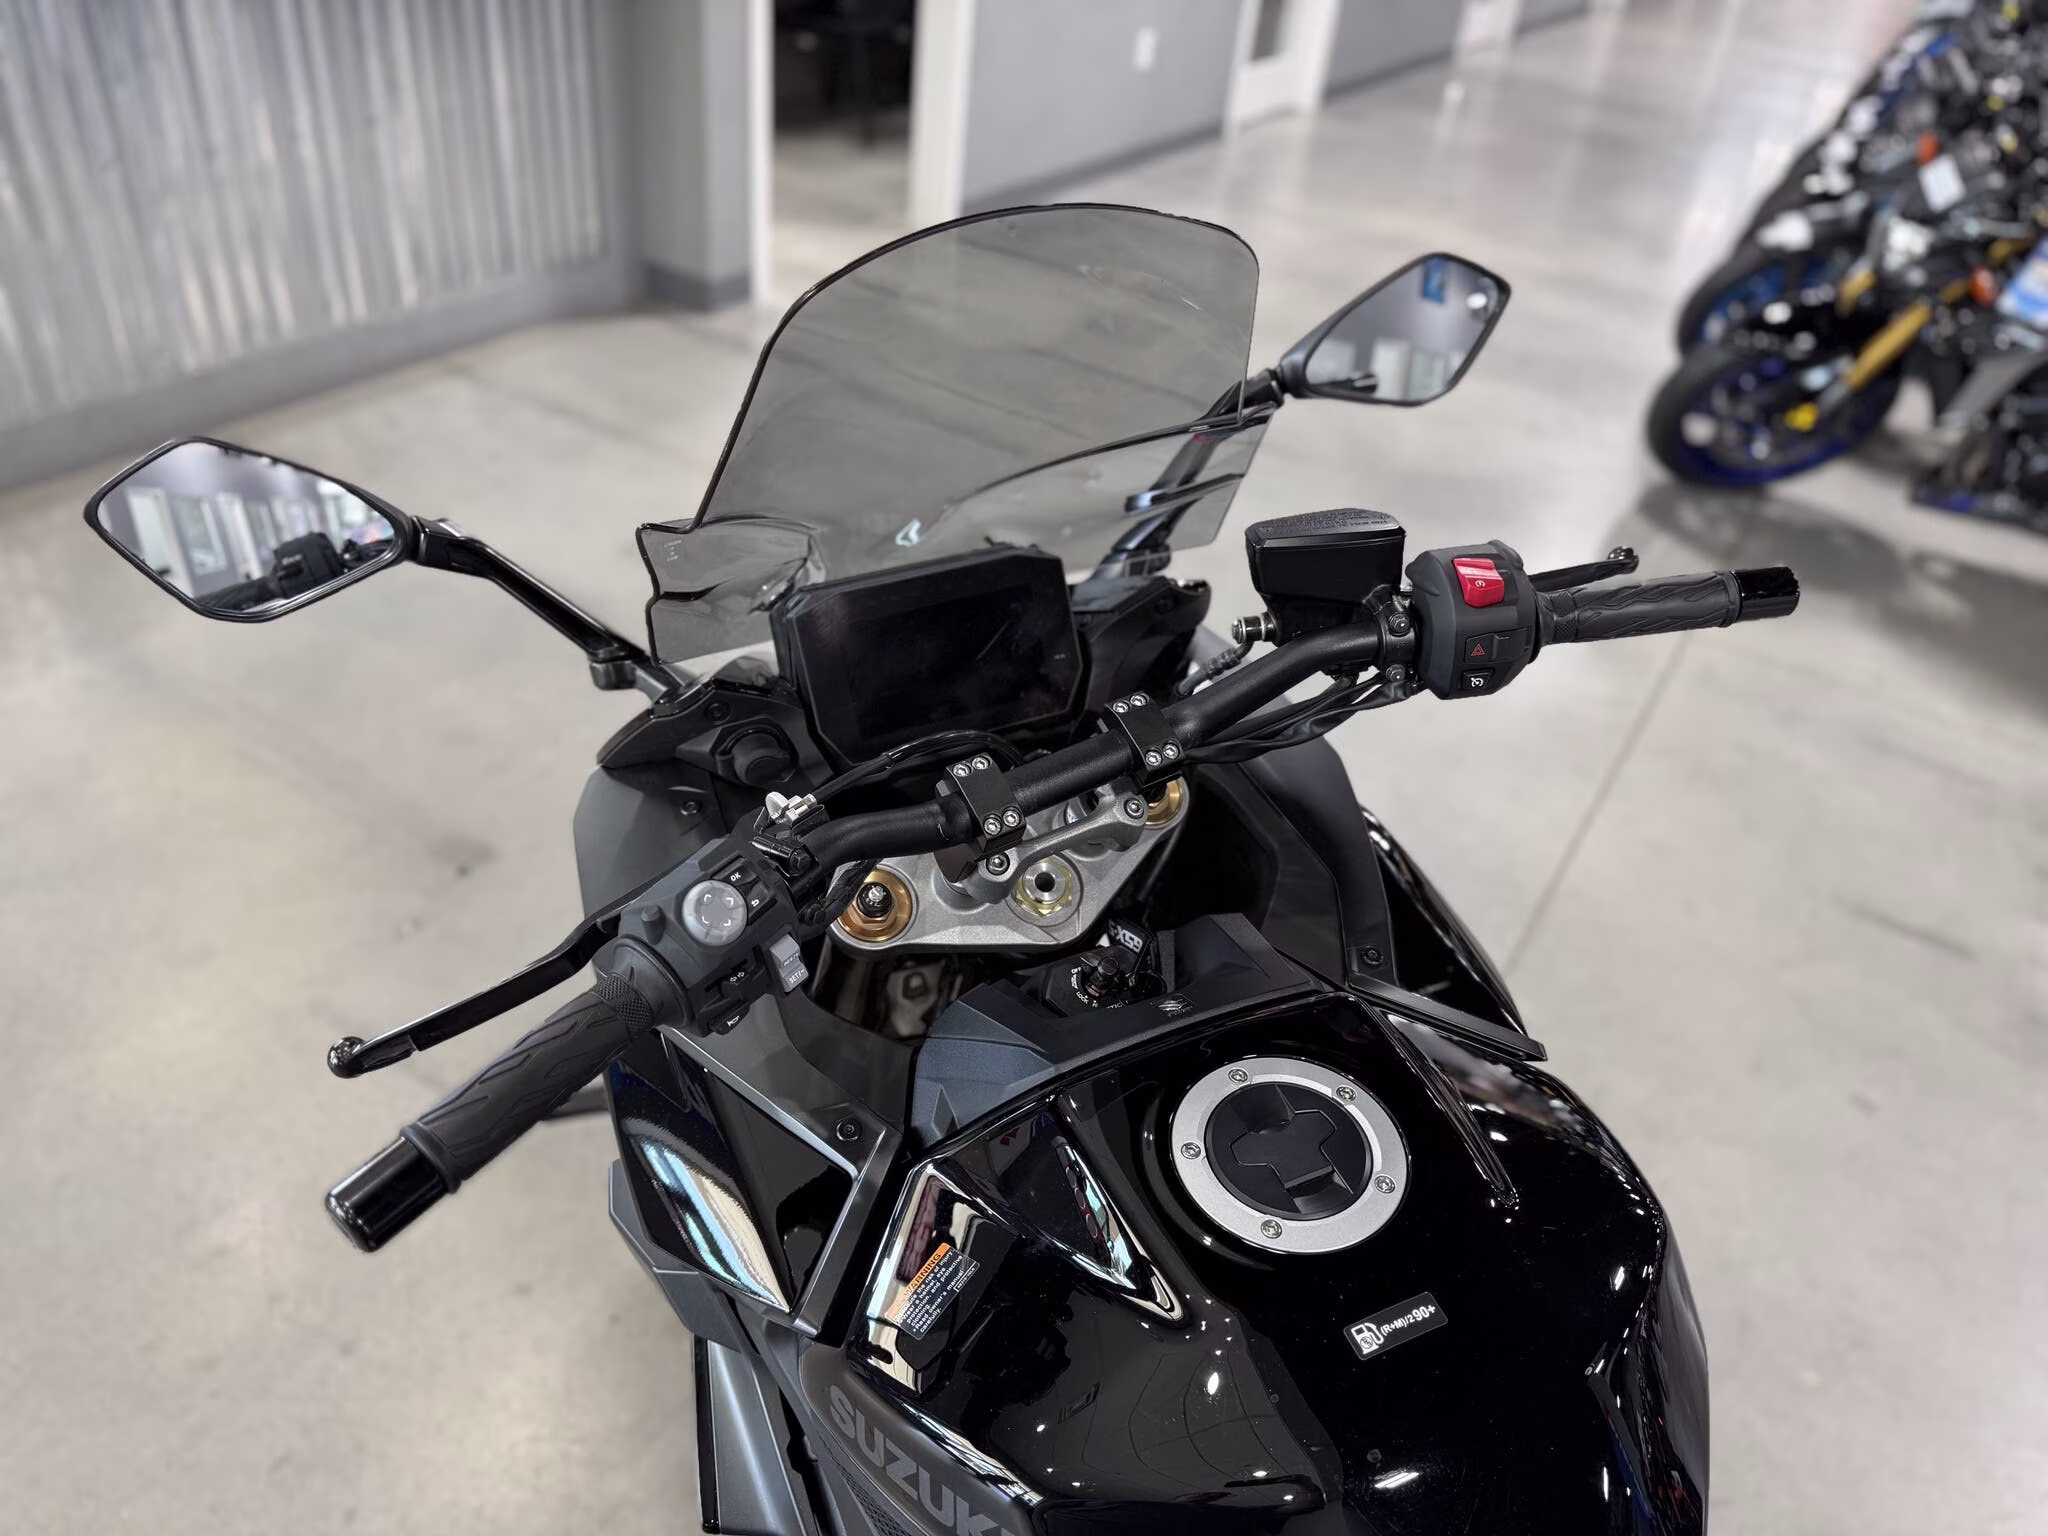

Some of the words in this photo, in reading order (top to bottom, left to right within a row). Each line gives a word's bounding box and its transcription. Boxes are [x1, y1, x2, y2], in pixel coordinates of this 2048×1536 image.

[730, 872, 741, 882] OK
[904, 1254, 941, 1297] WARNING
[917, 1284, 926, 1293] the
[931, 1283, 941, 1293] and
[1411, 1304, 1436, 1321] 90+
[830, 1384, 1012, 1536] SUZUK
